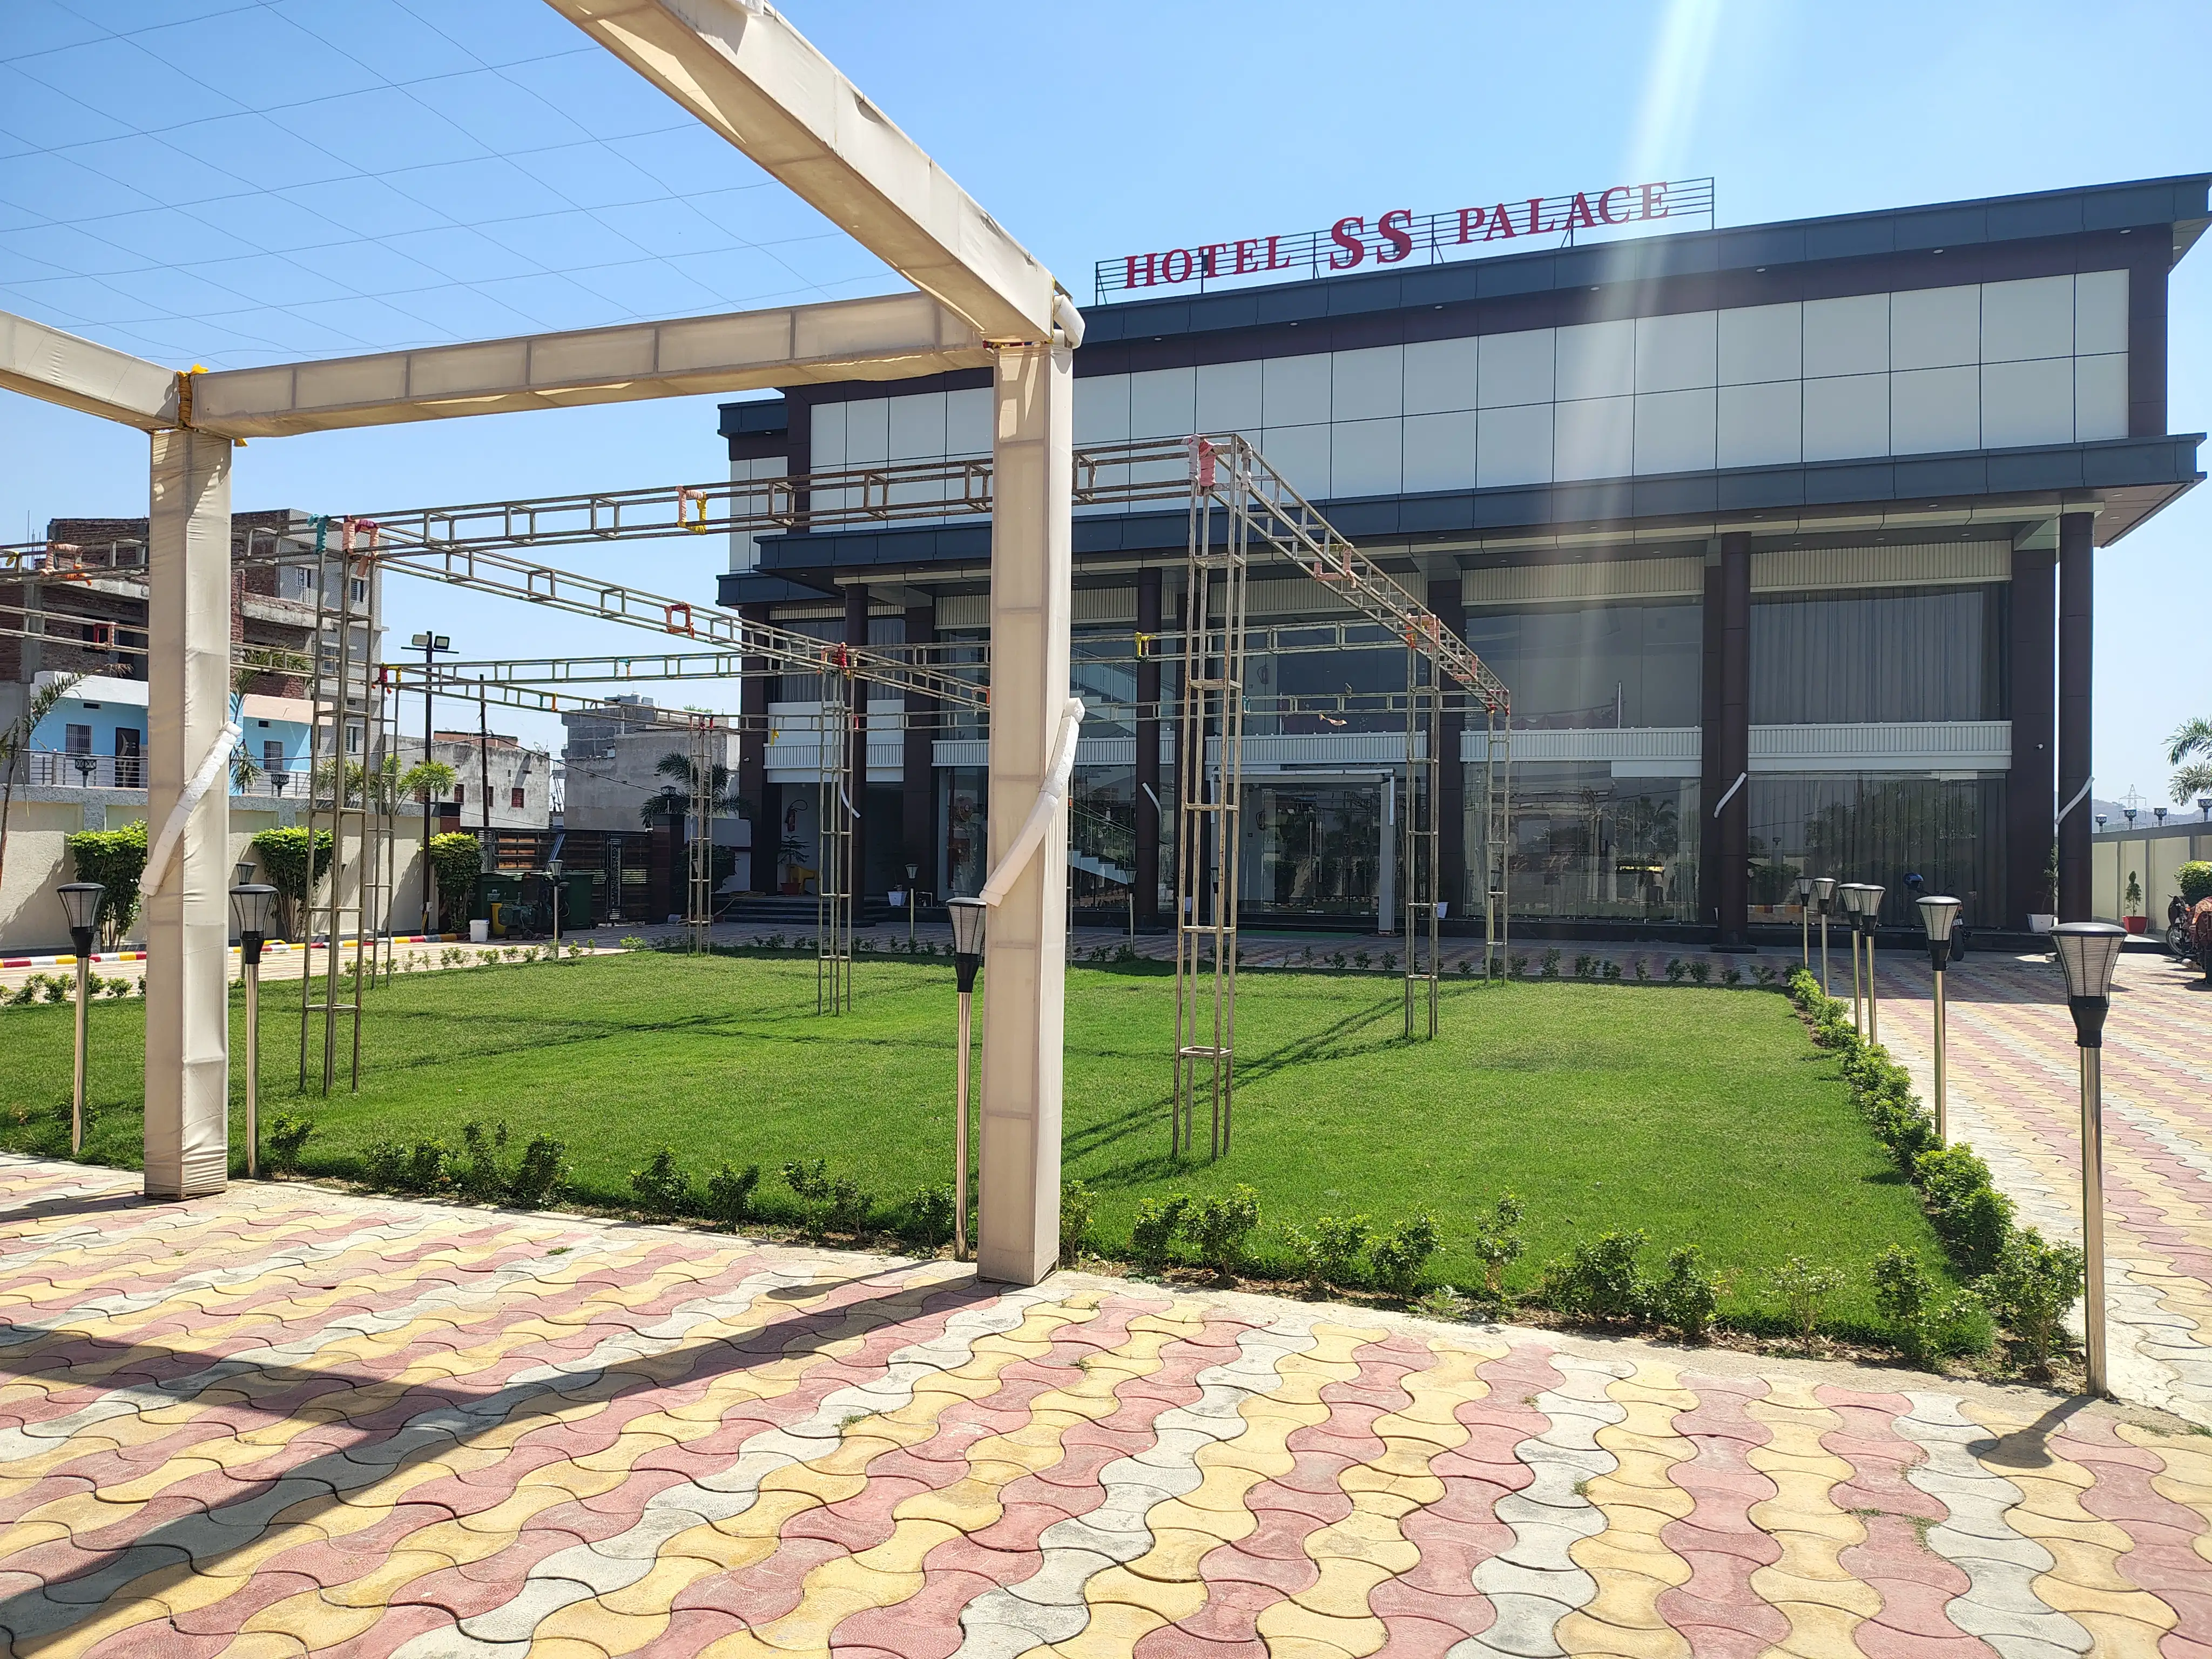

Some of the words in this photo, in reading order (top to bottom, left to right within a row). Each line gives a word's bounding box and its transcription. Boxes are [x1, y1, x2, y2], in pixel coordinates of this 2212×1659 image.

[1124, 235, 1291, 289] HOTEL
[1330, 209, 1412, 271] SS
[1456, 181, 1669, 245] PALACE
